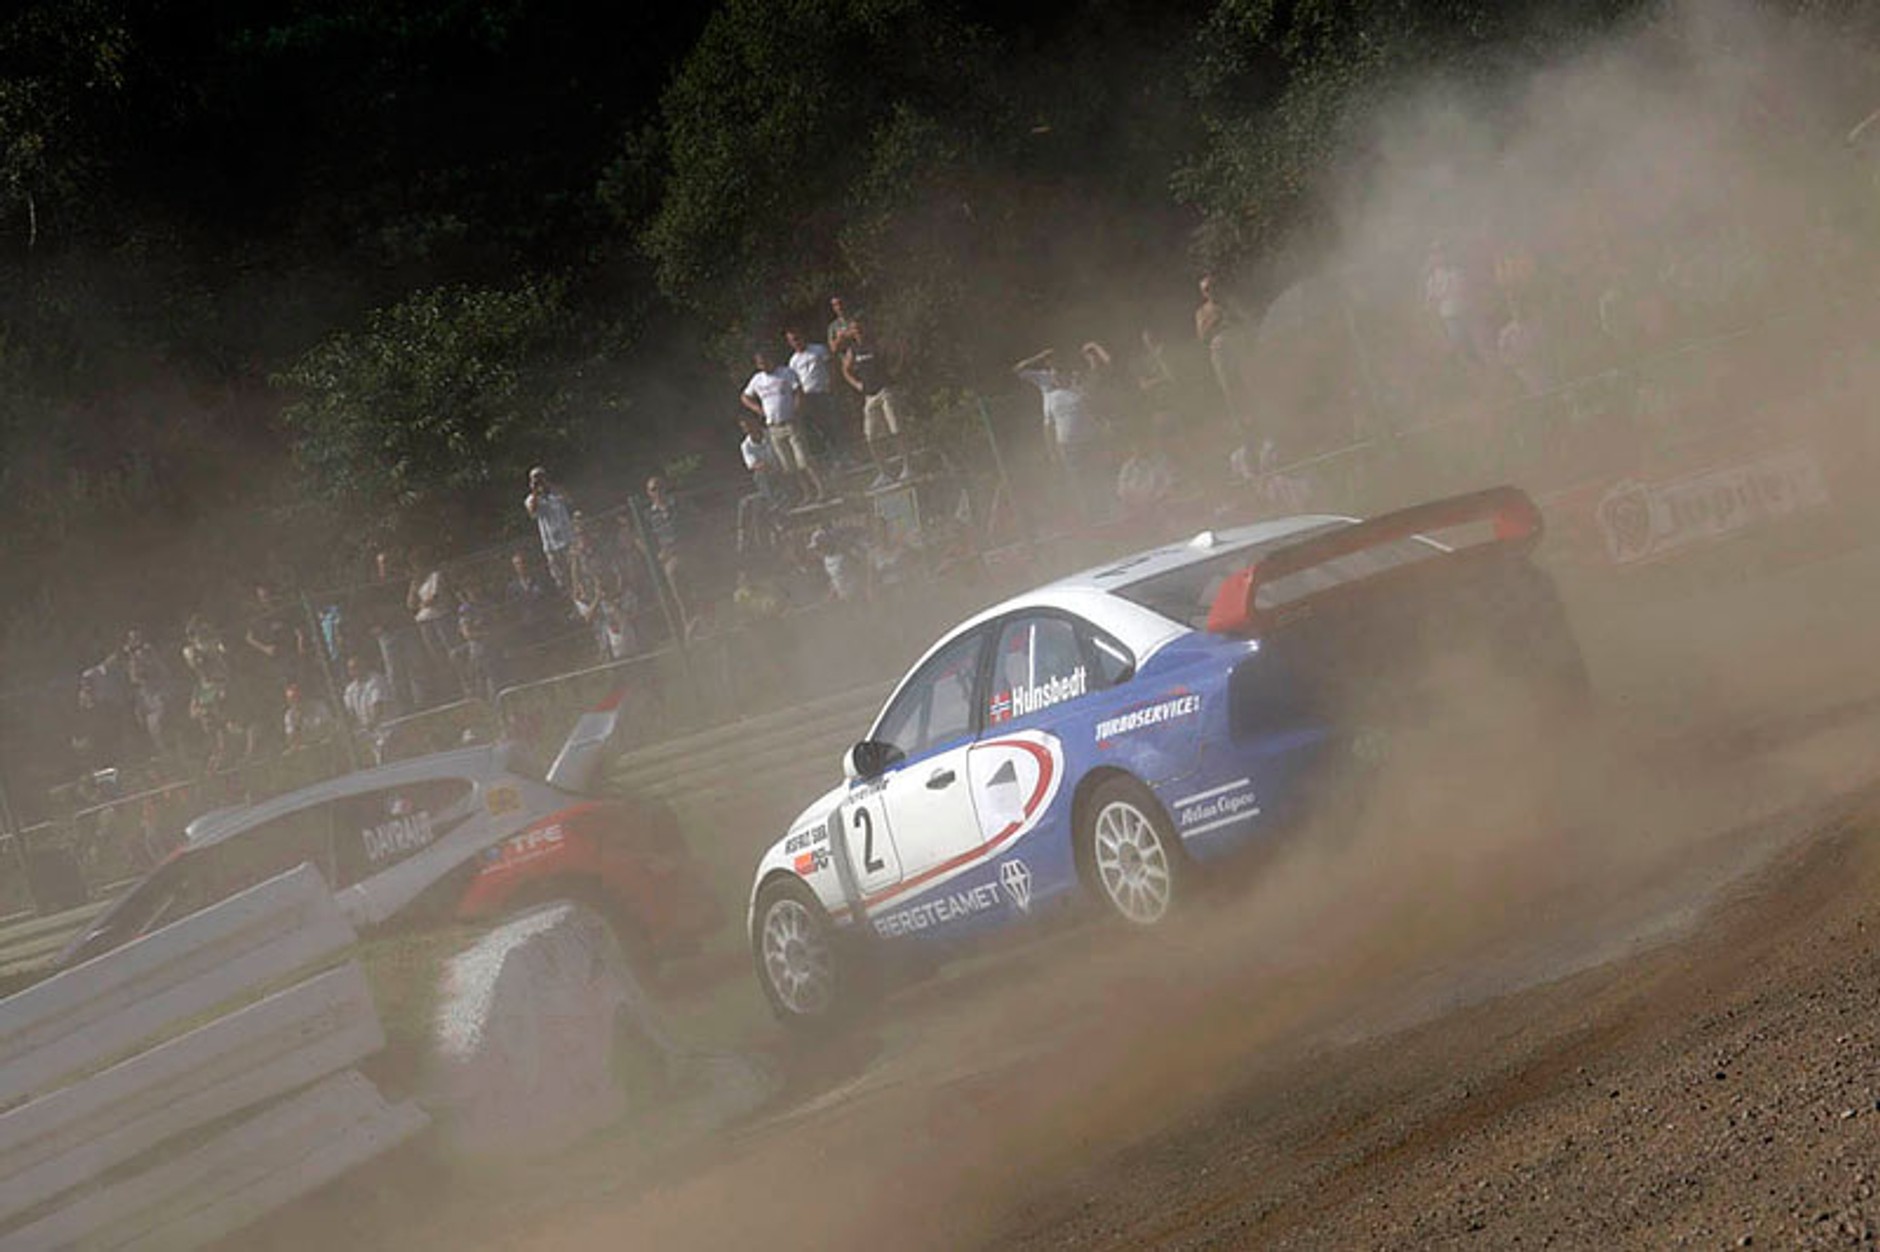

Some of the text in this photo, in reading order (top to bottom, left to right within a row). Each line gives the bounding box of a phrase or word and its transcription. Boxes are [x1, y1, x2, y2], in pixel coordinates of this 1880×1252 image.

[1012, 664, 1087, 718] Hunsbedt
[854, 806, 884, 875] 2
[873, 882, 1001, 939] BERGTEAMET
